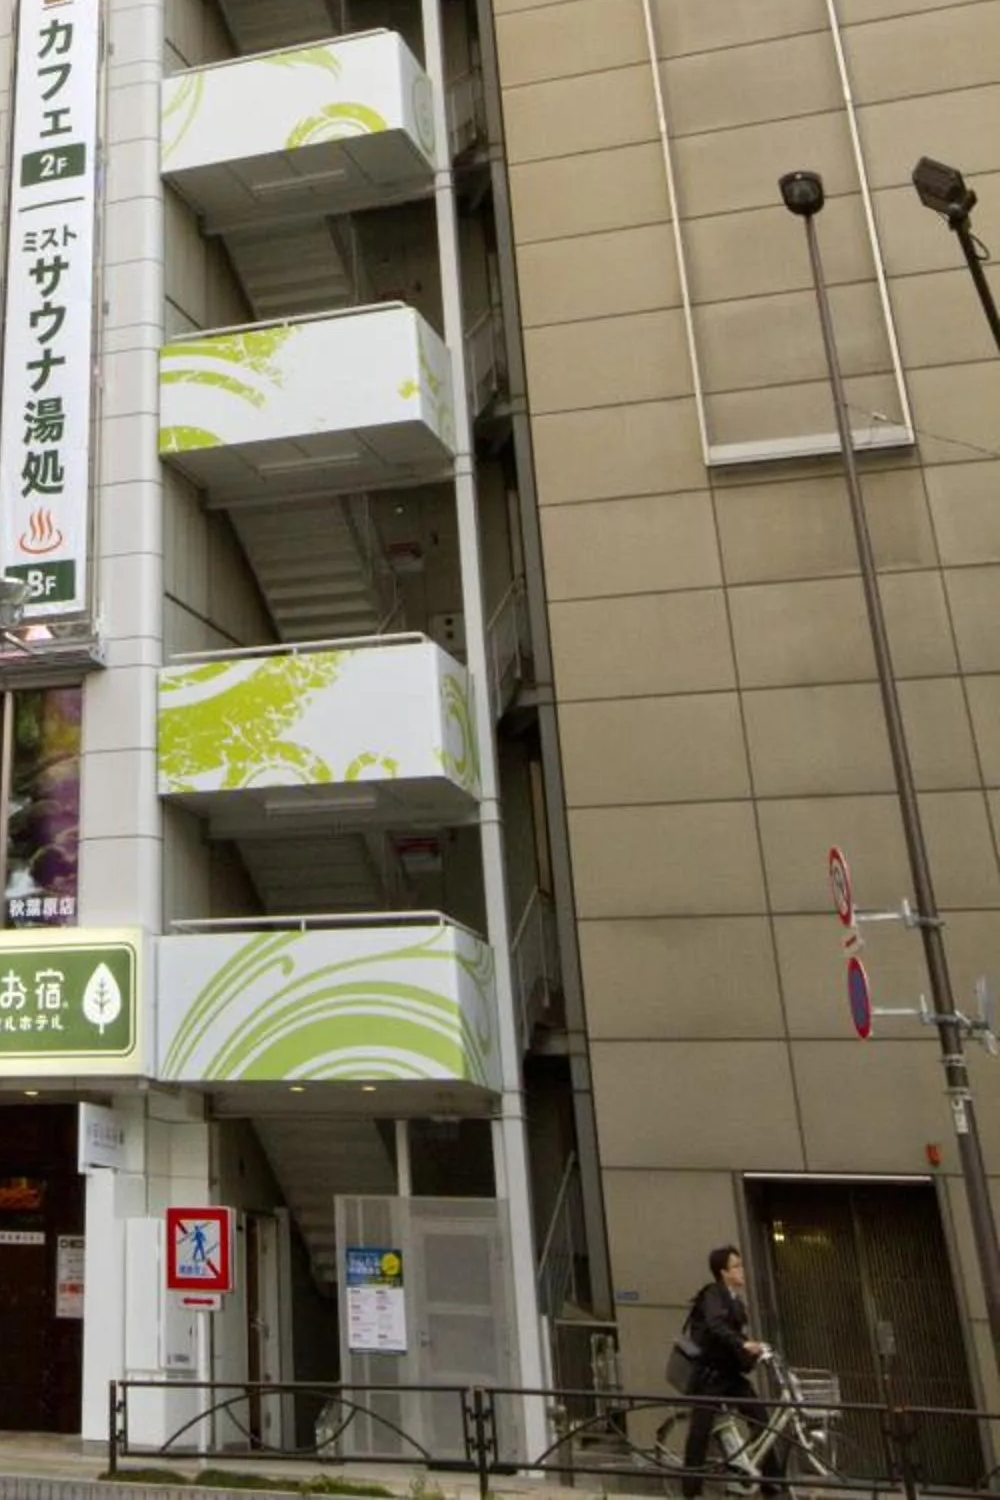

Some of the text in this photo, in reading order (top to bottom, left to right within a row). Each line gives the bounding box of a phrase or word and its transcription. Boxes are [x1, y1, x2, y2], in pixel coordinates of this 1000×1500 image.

[37, 18, 73, 139] カフェ
[39, 154, 68, 178] 2F
[22, 223, 78, 253] ミスト
[21, 253, 71, 499] サウナ湯処
